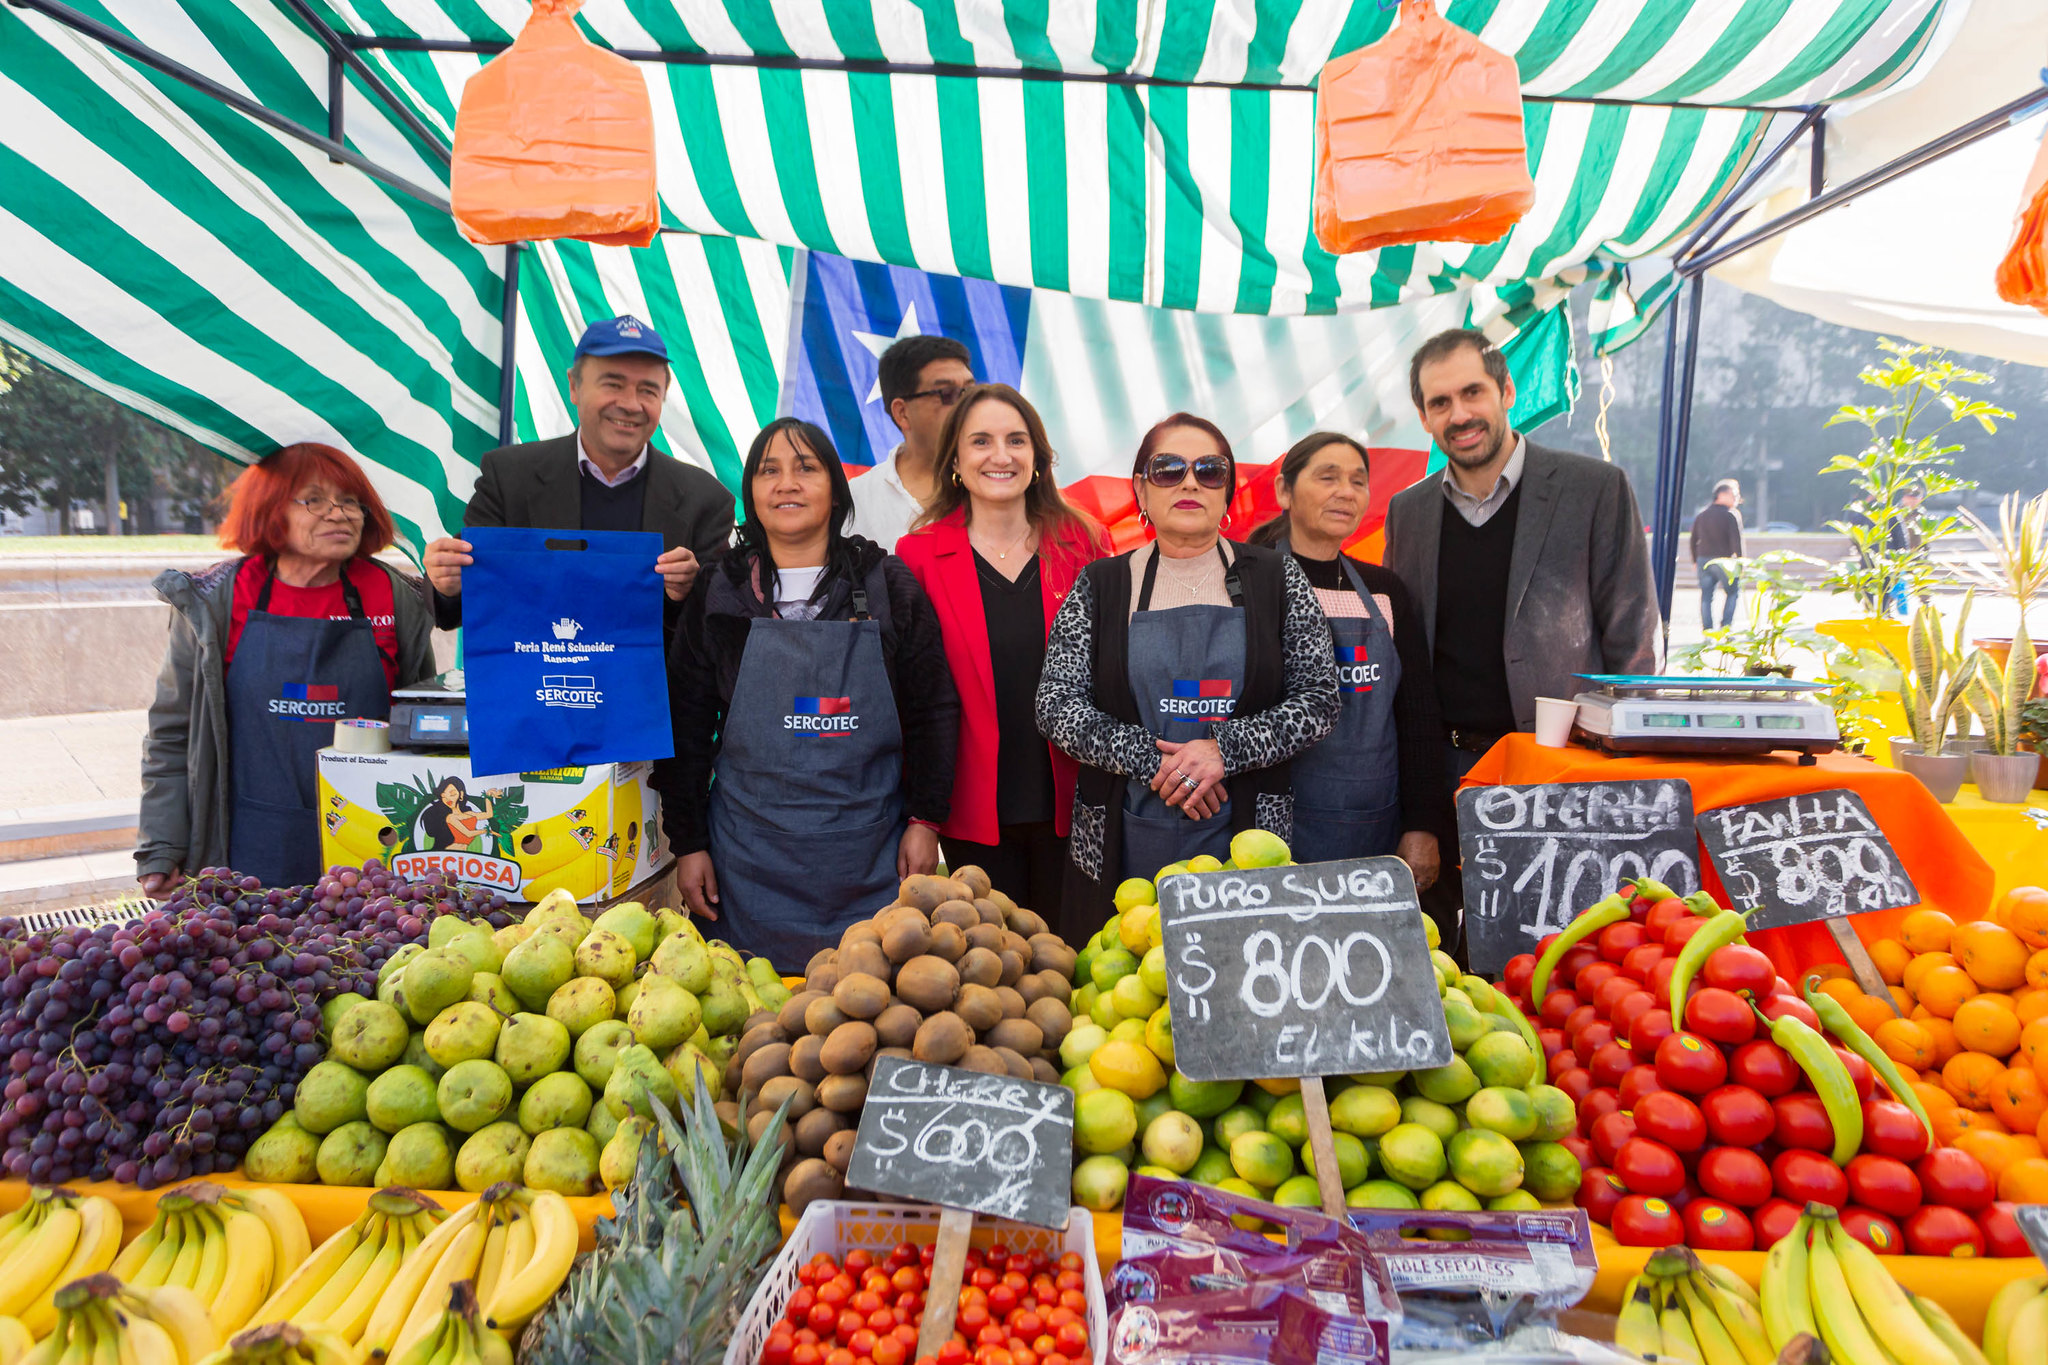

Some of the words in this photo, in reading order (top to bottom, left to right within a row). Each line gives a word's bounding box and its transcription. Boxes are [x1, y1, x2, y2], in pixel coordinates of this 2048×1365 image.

[514, 641, 540, 653] Feria
[541, 641, 566, 653] René
[567, 641, 615, 653] Schneider
[543, 654, 590, 664] Rancagua
[536, 688, 604, 703] SERCOTEC
[268, 699, 346, 716] SERCOTEC
[1160, 698, 1236, 714] SERCOTEC
[783, 715, 859, 731] SERCOTEC
[320, 755, 348, 763] Product
[358, 756, 388, 765] Ecuador
[1434, 1257, 1515, 1277] SEEDLESS
